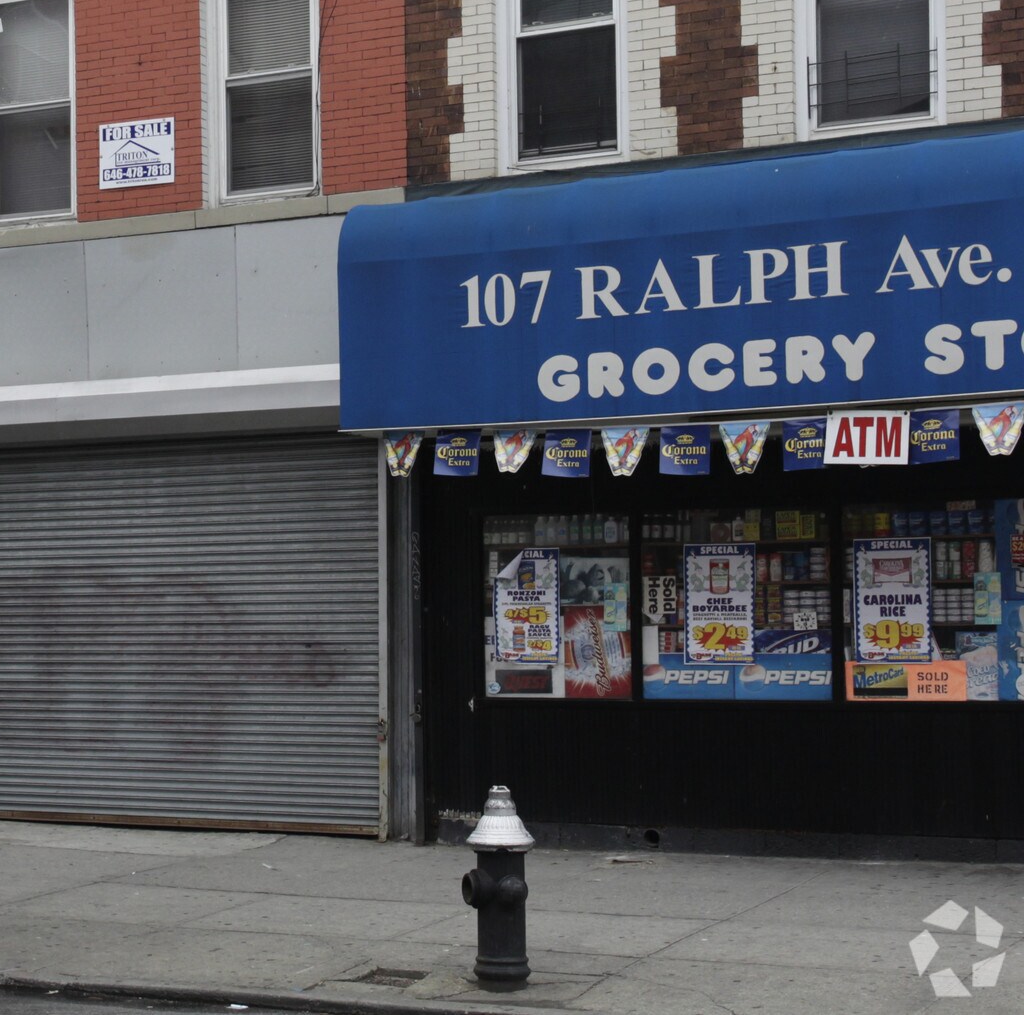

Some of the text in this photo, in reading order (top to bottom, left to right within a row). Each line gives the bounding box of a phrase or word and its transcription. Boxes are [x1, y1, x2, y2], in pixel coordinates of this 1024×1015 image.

[105, 122, 167, 141] FOR SALE
[117, 151, 148, 161] TRITON
[103, 164, 170, 181] 646-478-7818
[459, 234, 1012, 328] 107 RALPH Ave.
[537, 319, 1024, 403] GROCERY ST
[832, 417, 902, 457] ATM
[910, 429, 956, 445] Corona
[661, 444, 707, 458] Corona
[785, 438, 824, 452] Coron
[921, 442, 947, 452] Extra
[437, 446, 477, 459] Corona
[546, 446, 588, 459] Corona
[797, 449, 822, 459] Extra
[448, 458, 470, 467] Extra
[557, 459, 579, 468] Extra
[674, 456, 698, 466] Extra
[700, 545, 740, 554] SPECIAL
[871, 540, 913, 550] SPECIAL
[521, 550, 545, 559] CIAL
[648, 577, 660, 615] Here
[662, 578, 675, 615] Sold
[863, 594, 923, 605] CAROLINA
[880, 606, 906, 617] RICE
[586, 608, 613, 696] Budweiser
[664, 670, 730, 684] PEPSI
[764, 670, 833, 685] PEPSI
[853, 667, 904, 689] MetroCard
[917, 672, 949, 681] SOLD
[917, 684, 949, 694] HERE
